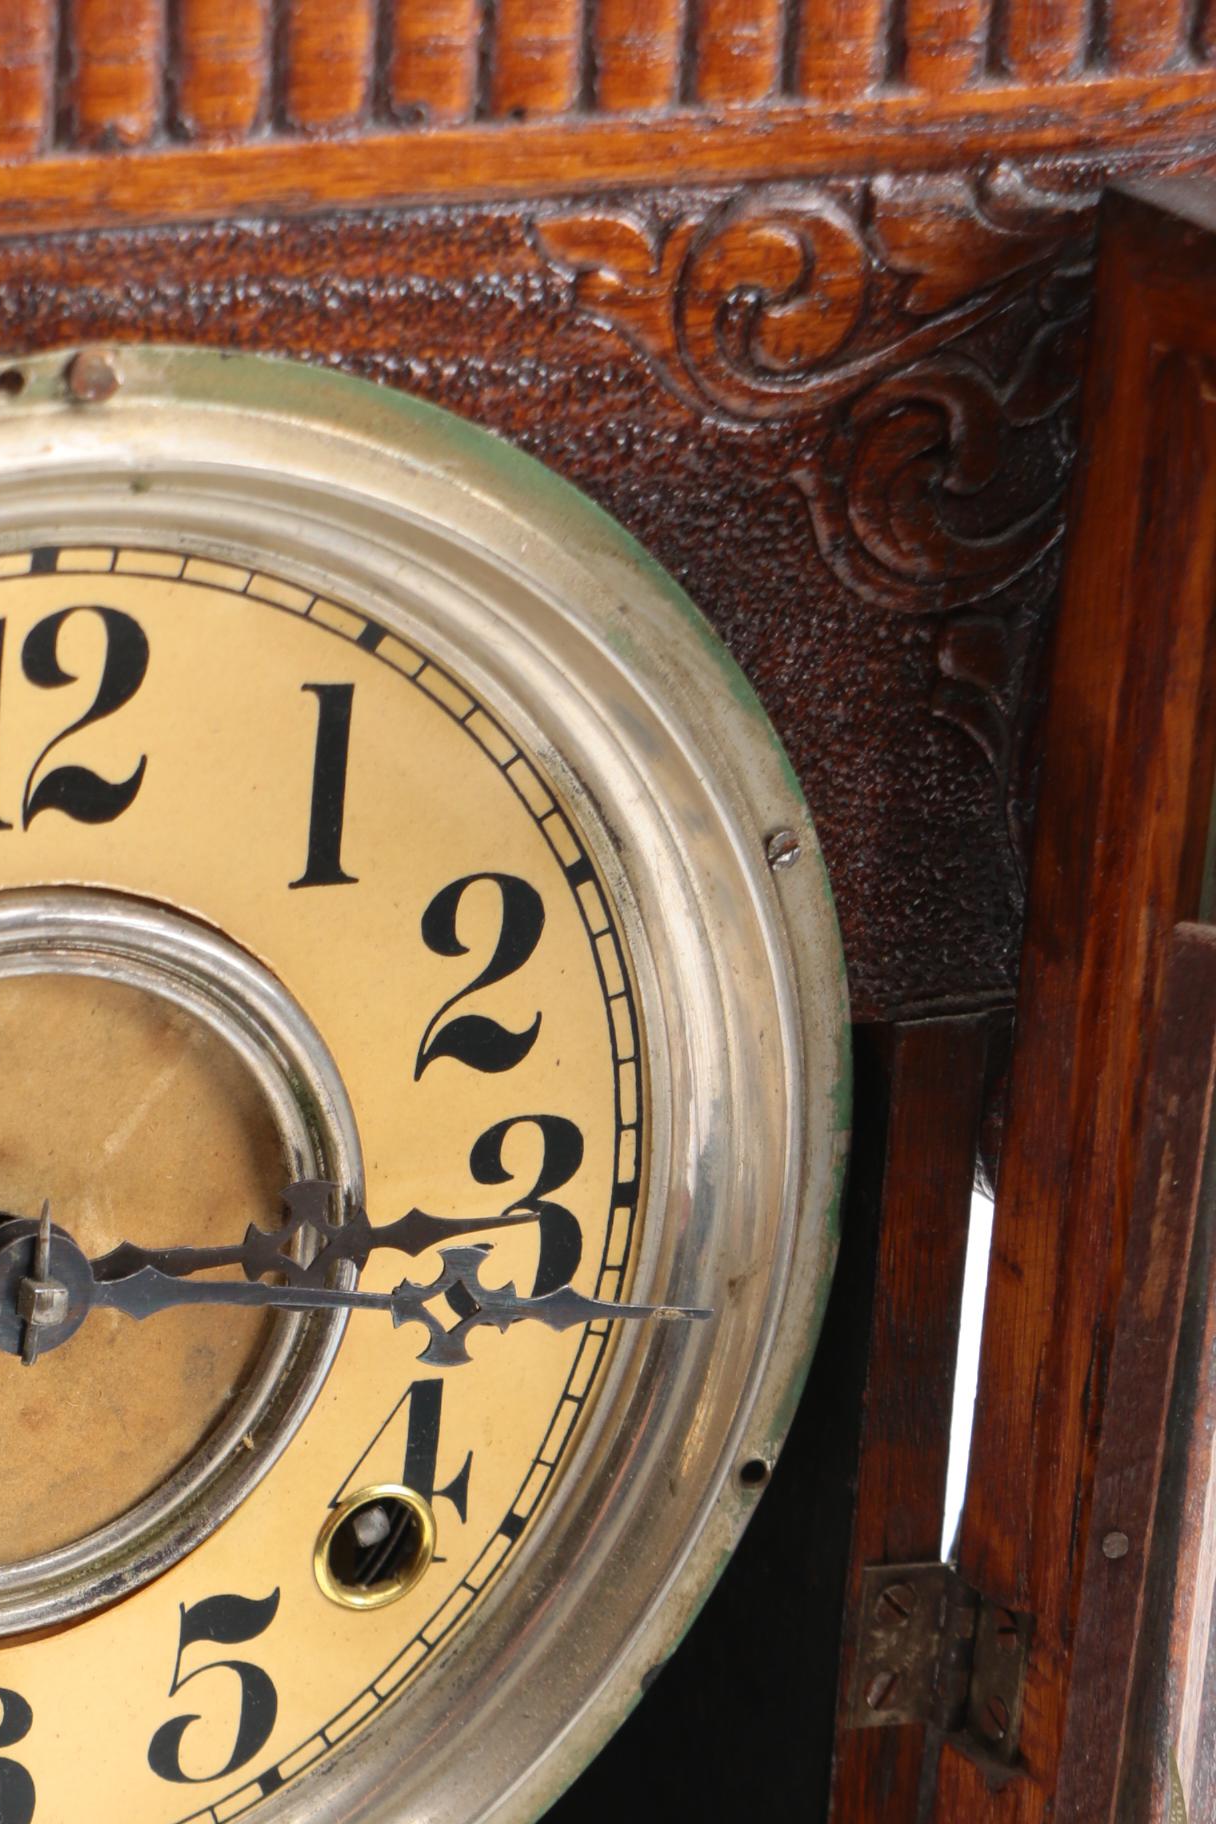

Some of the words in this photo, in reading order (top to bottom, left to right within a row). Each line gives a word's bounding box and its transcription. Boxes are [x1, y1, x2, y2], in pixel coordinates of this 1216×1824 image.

[289, 684, 359, 889] 1
[414, 873, 546, 1081] 2
[444, 1114, 585, 1327] 3
[328, 1379, 473, 1562] 4
[148, 1588, 281, 1784] 5
